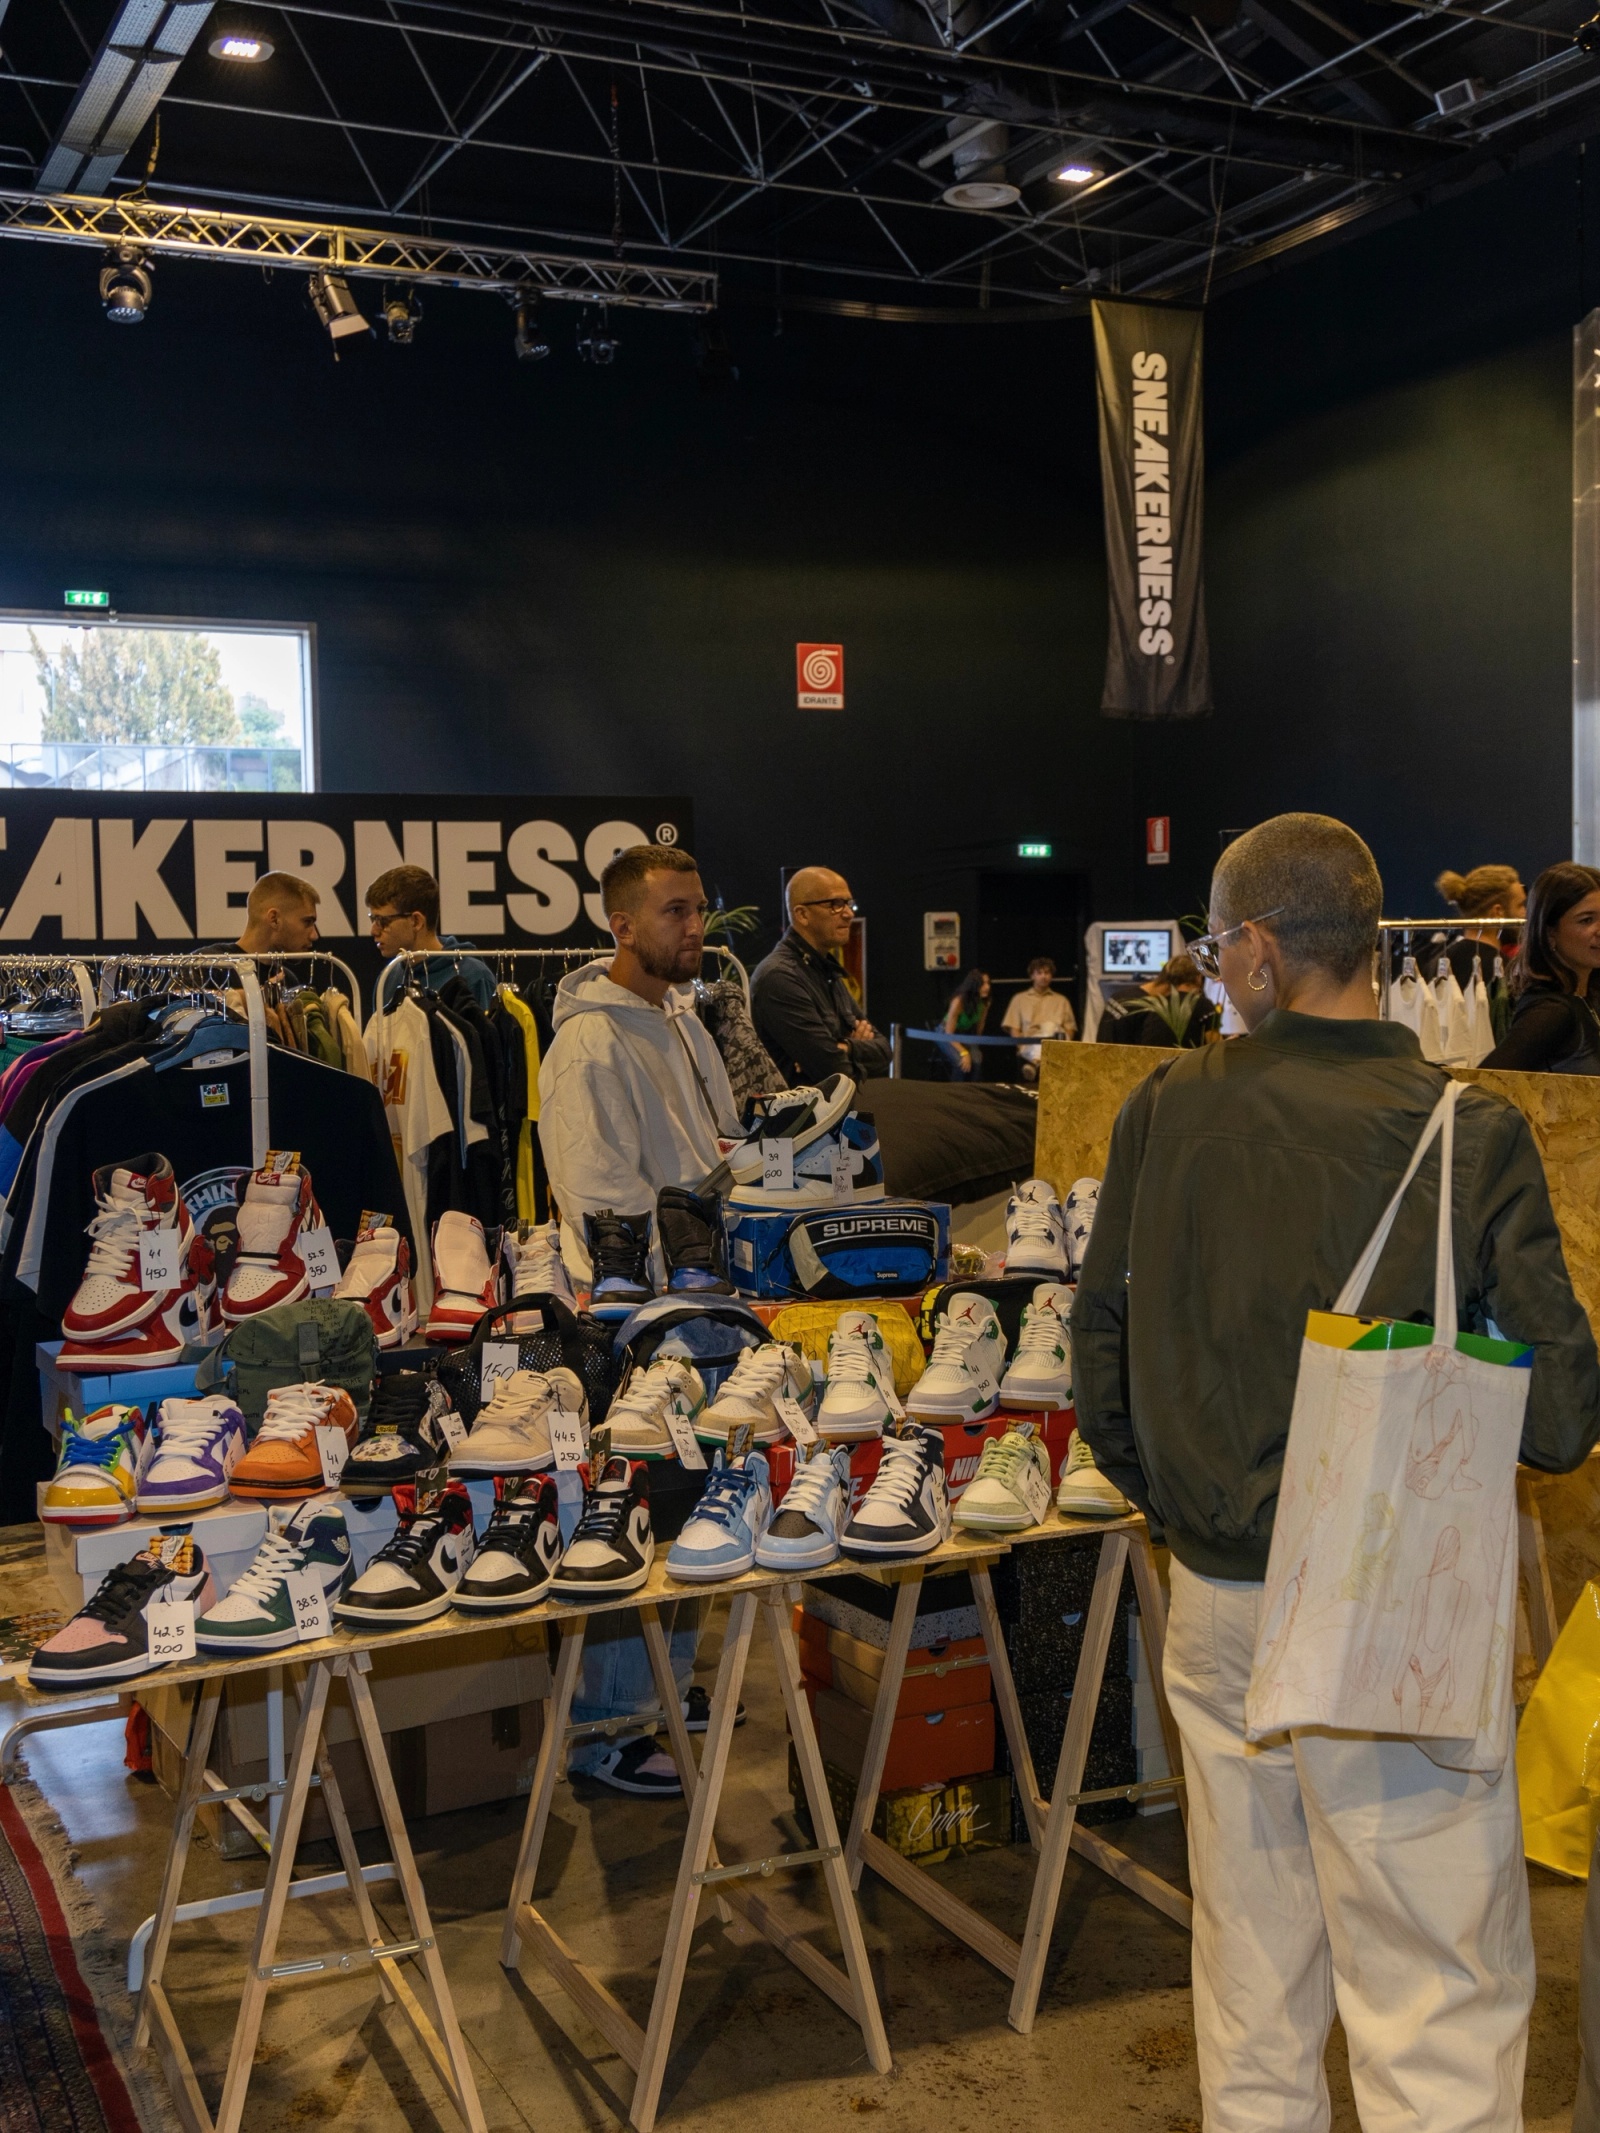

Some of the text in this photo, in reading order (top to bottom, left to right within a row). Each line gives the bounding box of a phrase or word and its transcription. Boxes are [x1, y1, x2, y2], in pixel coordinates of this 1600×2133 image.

[803, 696, 838, 705] IDRANTE
[768, 1153, 779, 1161] 39
[764, 1169, 783, 1179] 600
[823, 1218, 929, 1237] SUPREME
[148, 1249, 161, 1259] 41
[145, 1267, 168, 1281] 450
[308, 1264, 328, 1278] 350
[876, 1271, 898, 1280] Supreme
[482, 1362, 516, 1383] 150
[970, 1364, 980, 1375] 41
[977, 1379, 991, 1392] 500
[554, 1429, 576, 1443] 44.5
[326, 1450, 339, 1466] 41
[560, 1451, 581, 1462] 250
[950, 1456, 981, 1482] NIK
[295, 1594, 319, 1611] 38.5
[300, 1616, 320, 1630] 200
[153, 1625, 186, 1639] 42.5
[153, 1643, 184, 1656] 200
